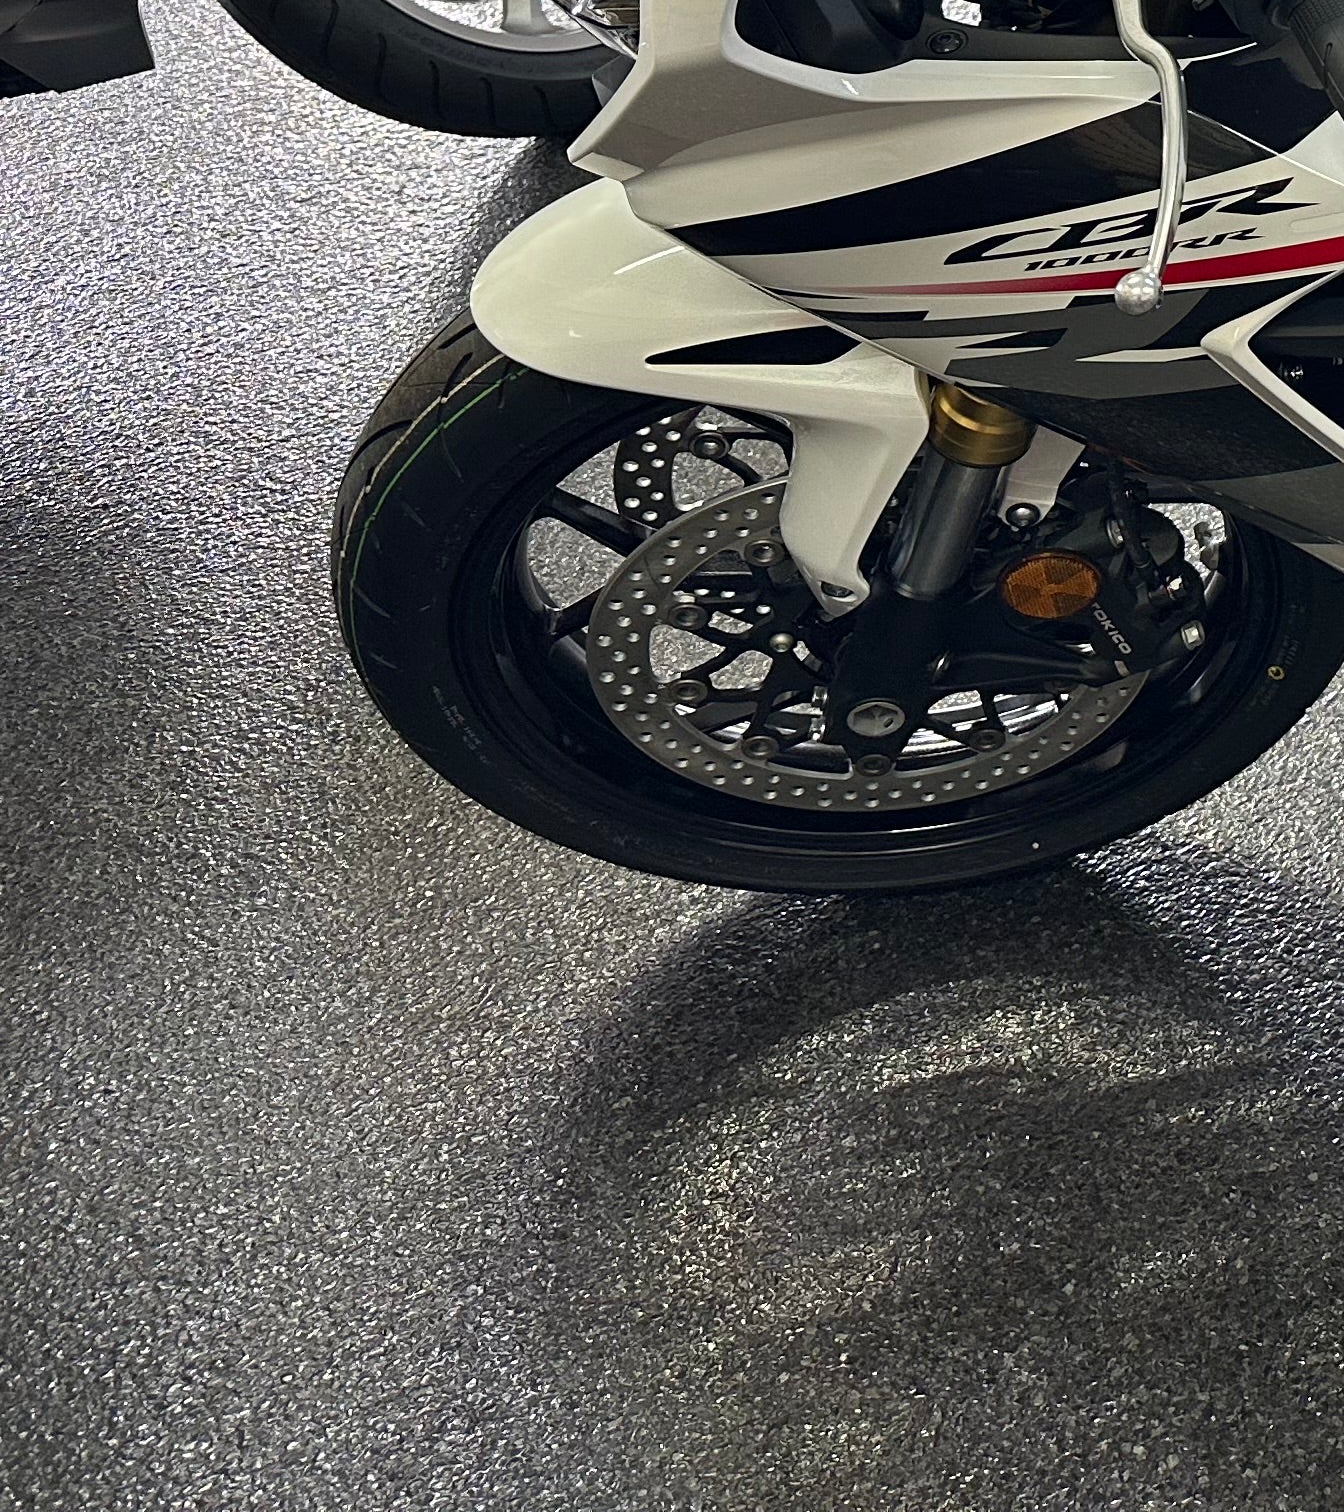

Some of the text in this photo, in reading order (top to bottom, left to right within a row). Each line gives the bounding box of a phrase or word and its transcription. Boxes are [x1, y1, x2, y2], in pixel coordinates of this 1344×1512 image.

[943, 177, 1320, 265] CBR
[1024, 227, 1267, 272] 1000RR
[1092, 602, 1131, 654] TOKICO
